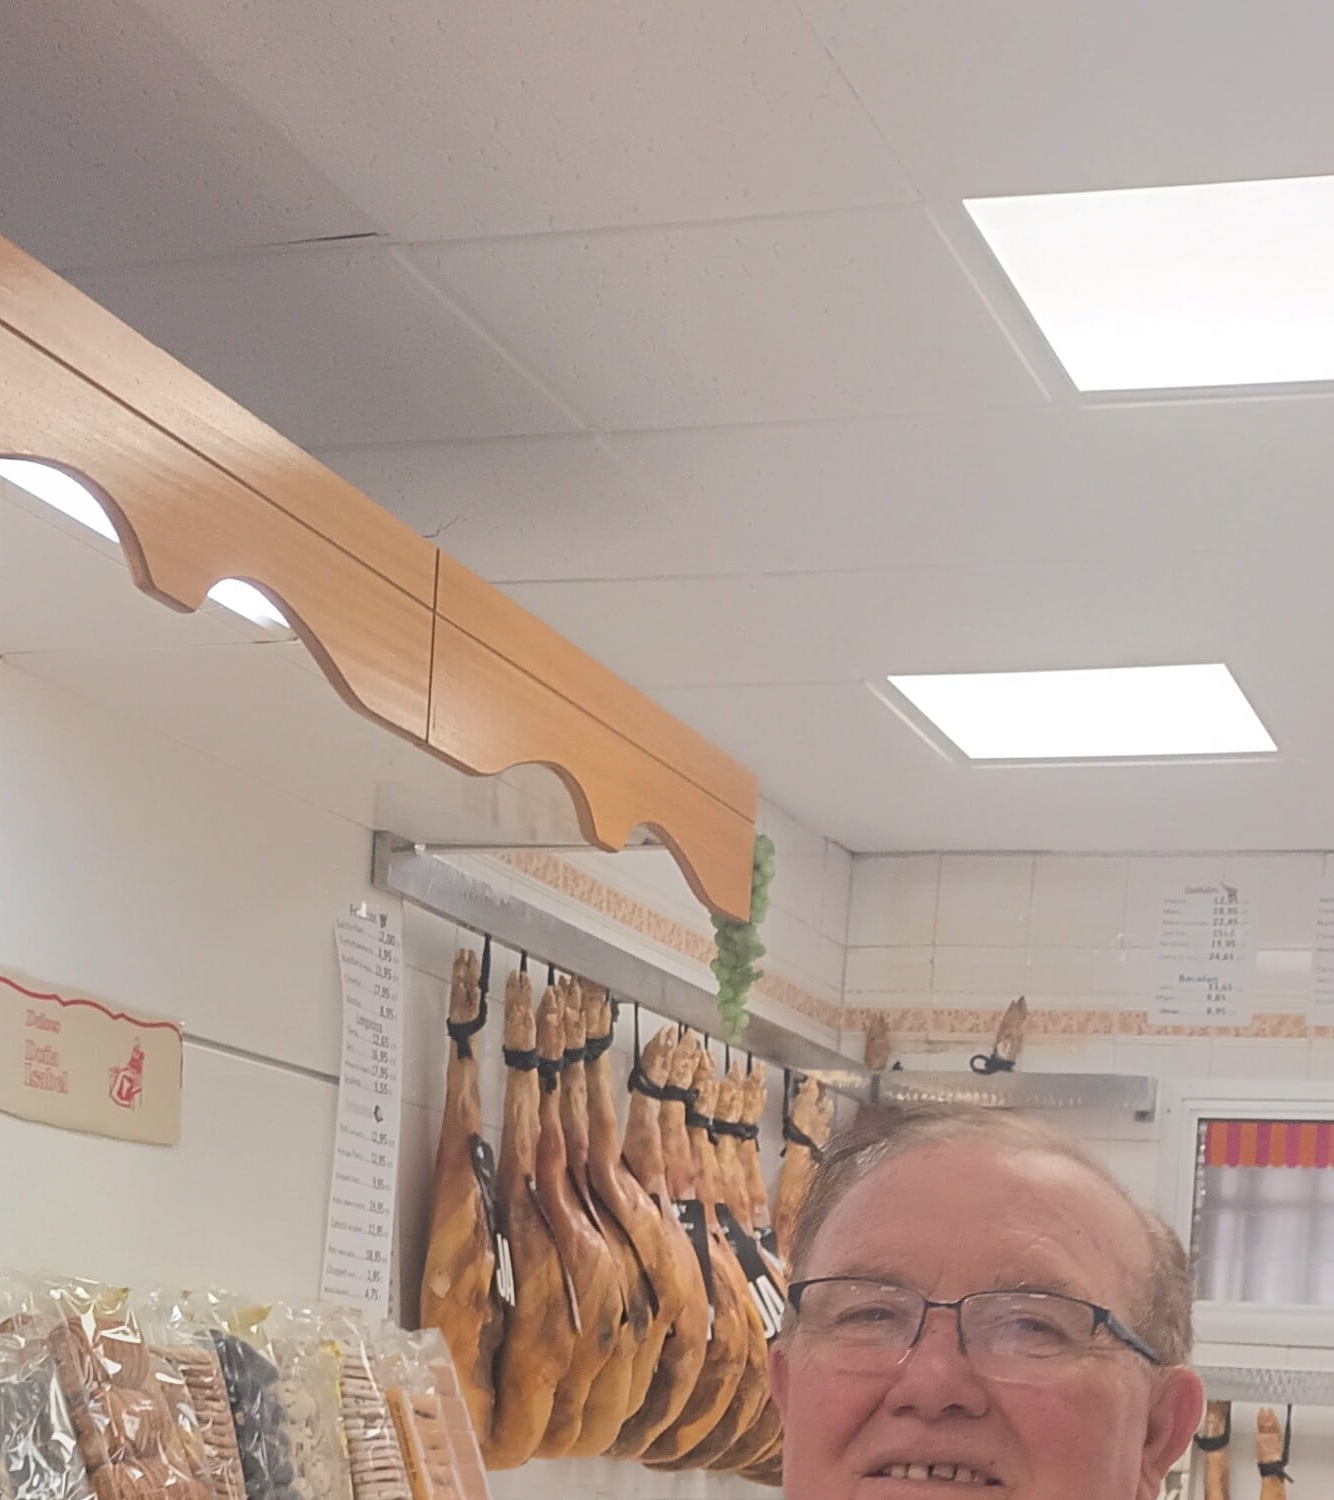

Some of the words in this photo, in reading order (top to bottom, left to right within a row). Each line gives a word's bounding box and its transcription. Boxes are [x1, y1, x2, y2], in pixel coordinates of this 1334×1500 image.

[25, 1008, 61, 1034] Dulces
[24, 1038, 60, 1067] Doña
[24, 1061, 68, 1094] Isabel
